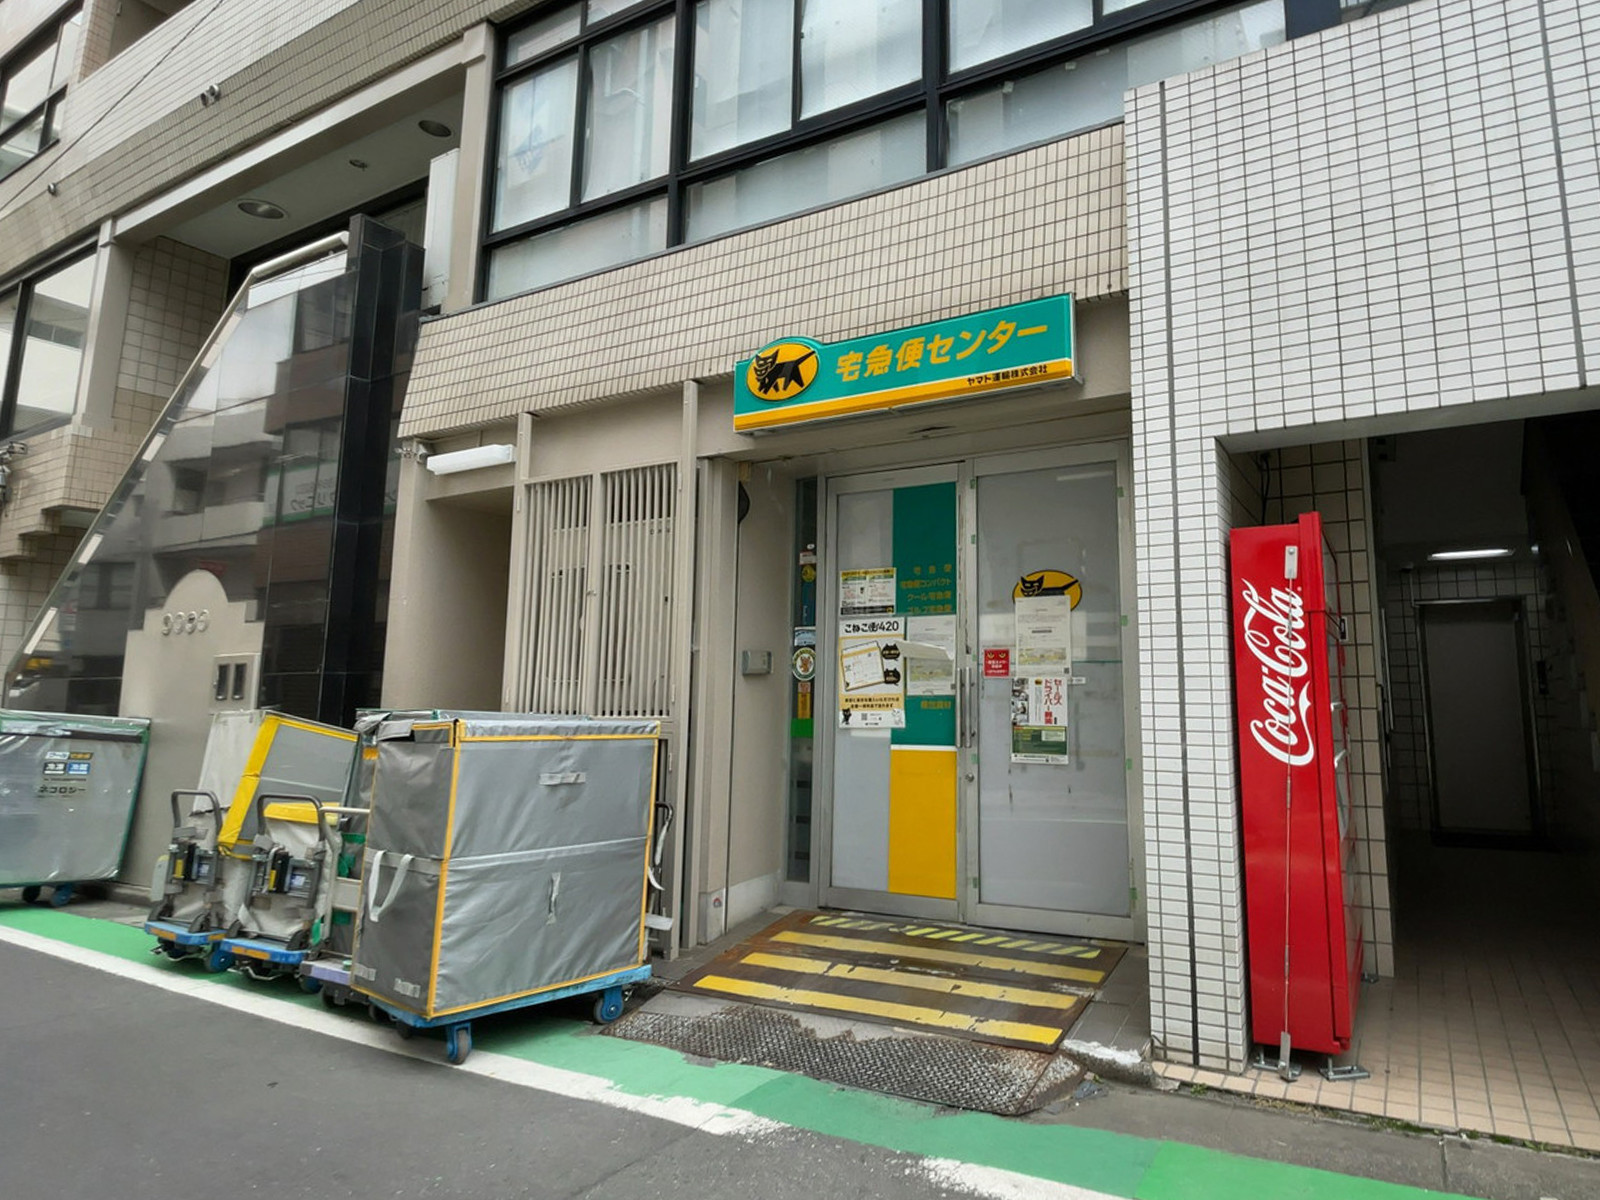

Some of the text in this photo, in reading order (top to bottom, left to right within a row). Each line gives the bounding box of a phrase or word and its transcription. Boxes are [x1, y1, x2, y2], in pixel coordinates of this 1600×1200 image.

[836, 320, 1048, 382] 宅急便センター
[967, 364, 1048, 386] ヤマト運輸株式会社
[1241, 578, 1315, 767] Coca-Cola
